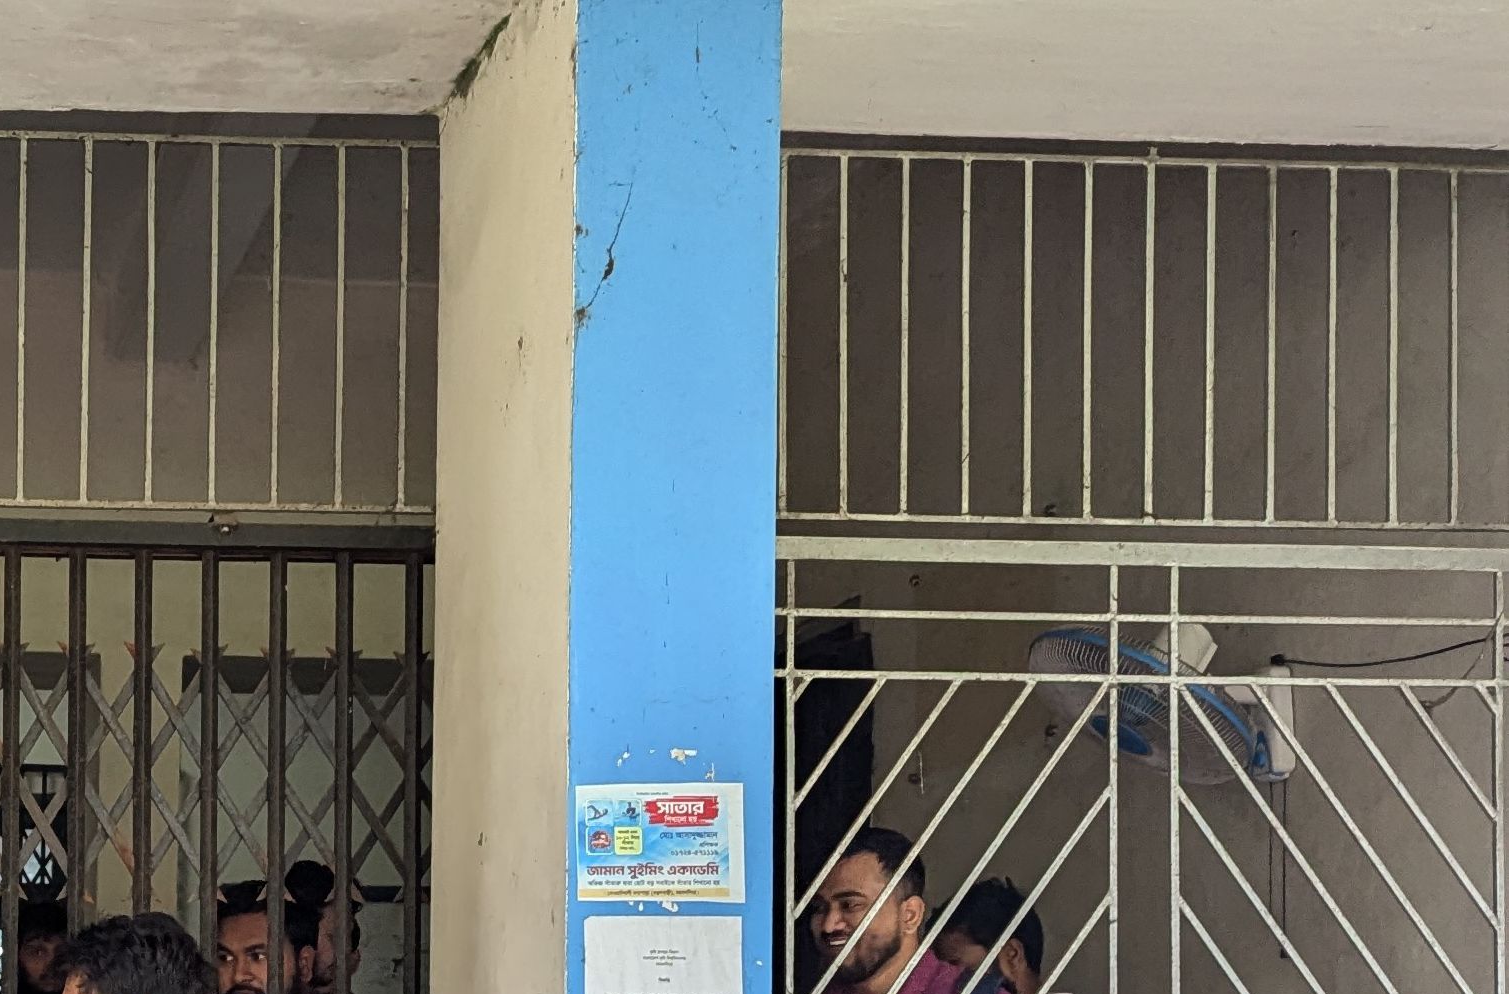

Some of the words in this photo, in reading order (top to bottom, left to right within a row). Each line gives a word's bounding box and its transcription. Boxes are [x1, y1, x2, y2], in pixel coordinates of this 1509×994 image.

[656, 801, 705, 815] সাতার
[587, 864, 625, 876] জামান
[627, 862, 664, 879] সুইমিং
[667, 861, 720, 876] একাডেমি
